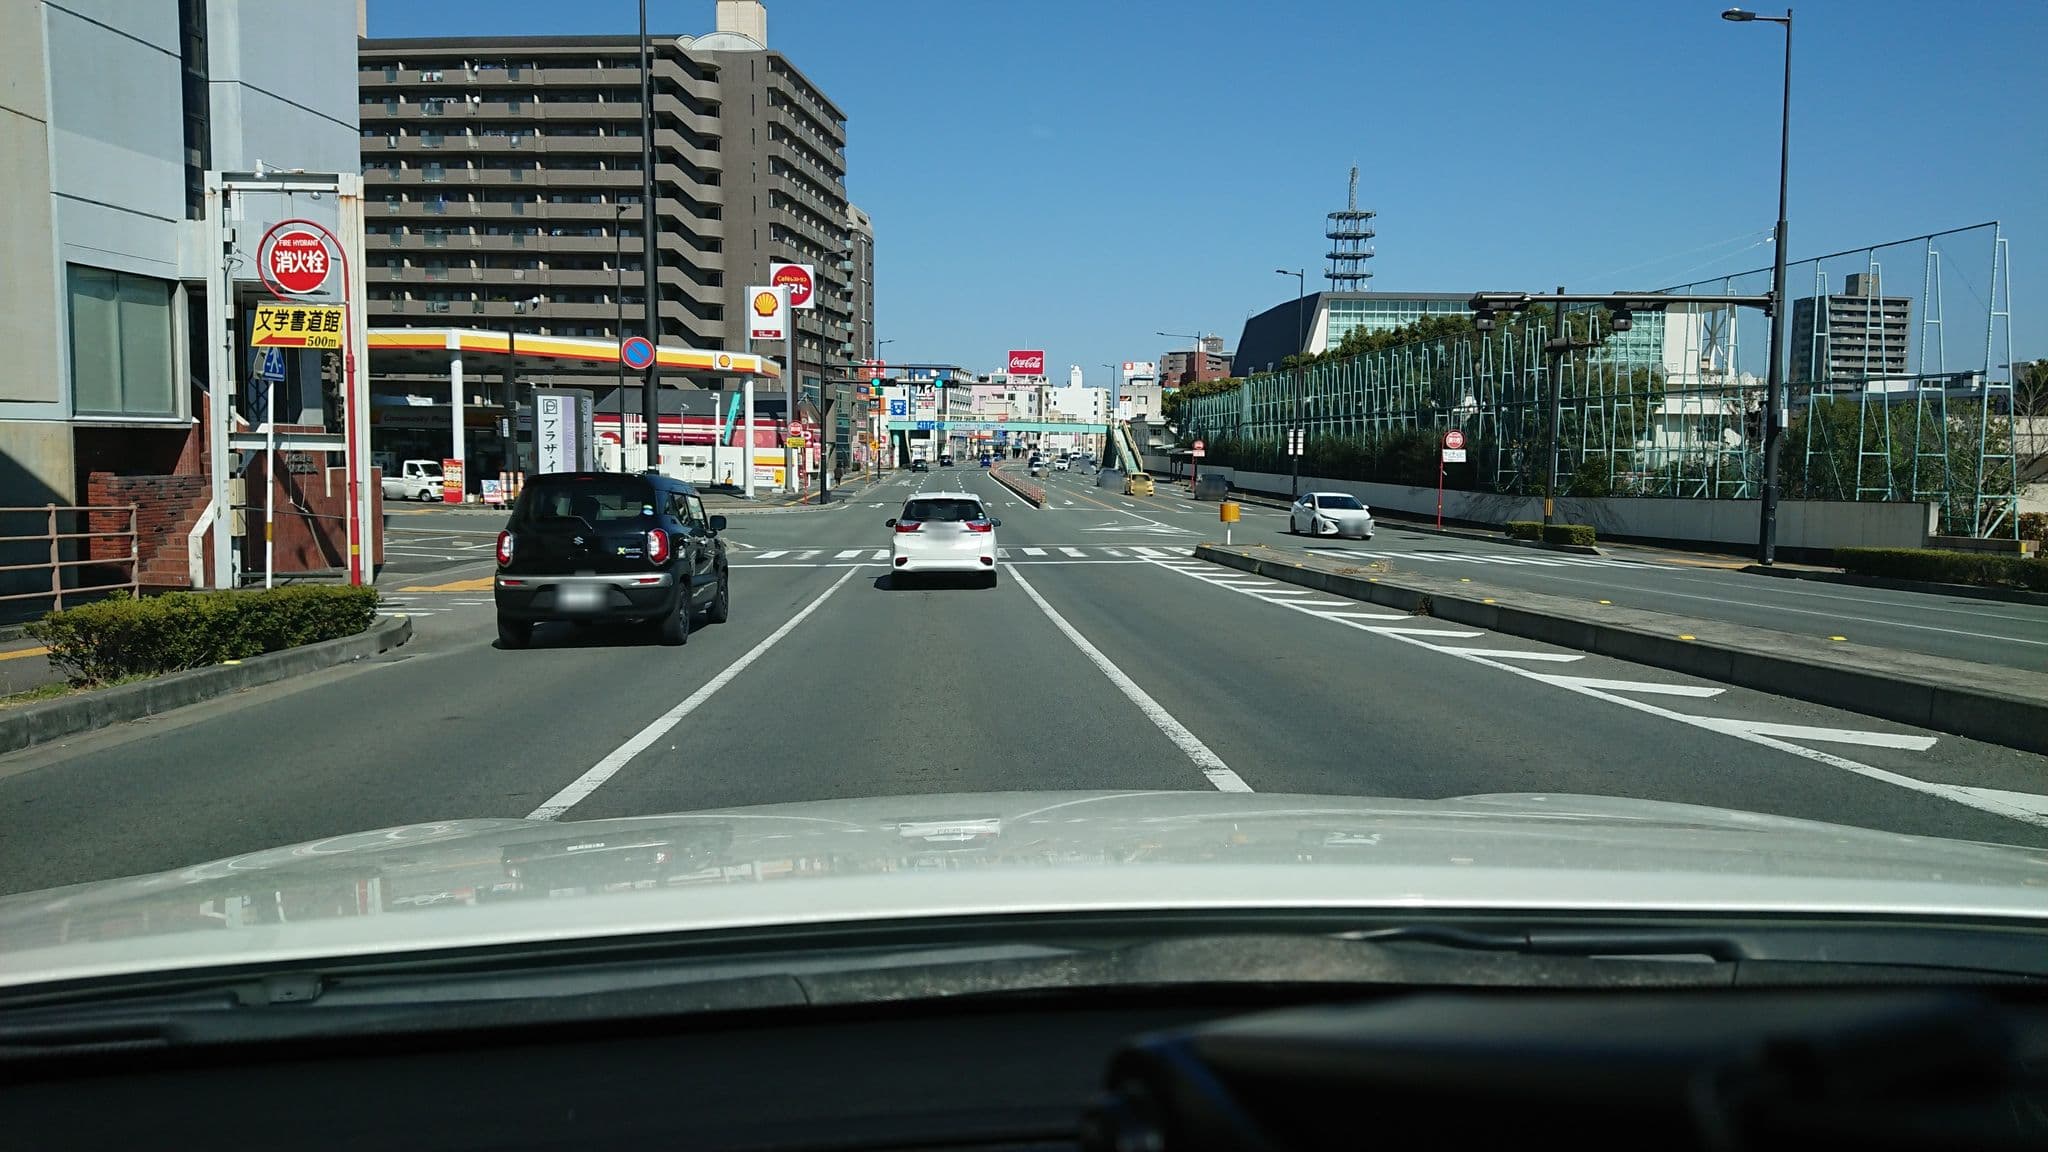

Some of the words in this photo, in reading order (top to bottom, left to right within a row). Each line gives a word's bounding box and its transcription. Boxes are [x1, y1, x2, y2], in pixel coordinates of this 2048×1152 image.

[279, 239, 293, 247] FIRE
[293, 239, 319, 247] HYDRANT
[275, 250, 325, 273] 消火栓
[256, 308, 341, 333] 文学書道館
[307, 336, 336, 347] 500m
